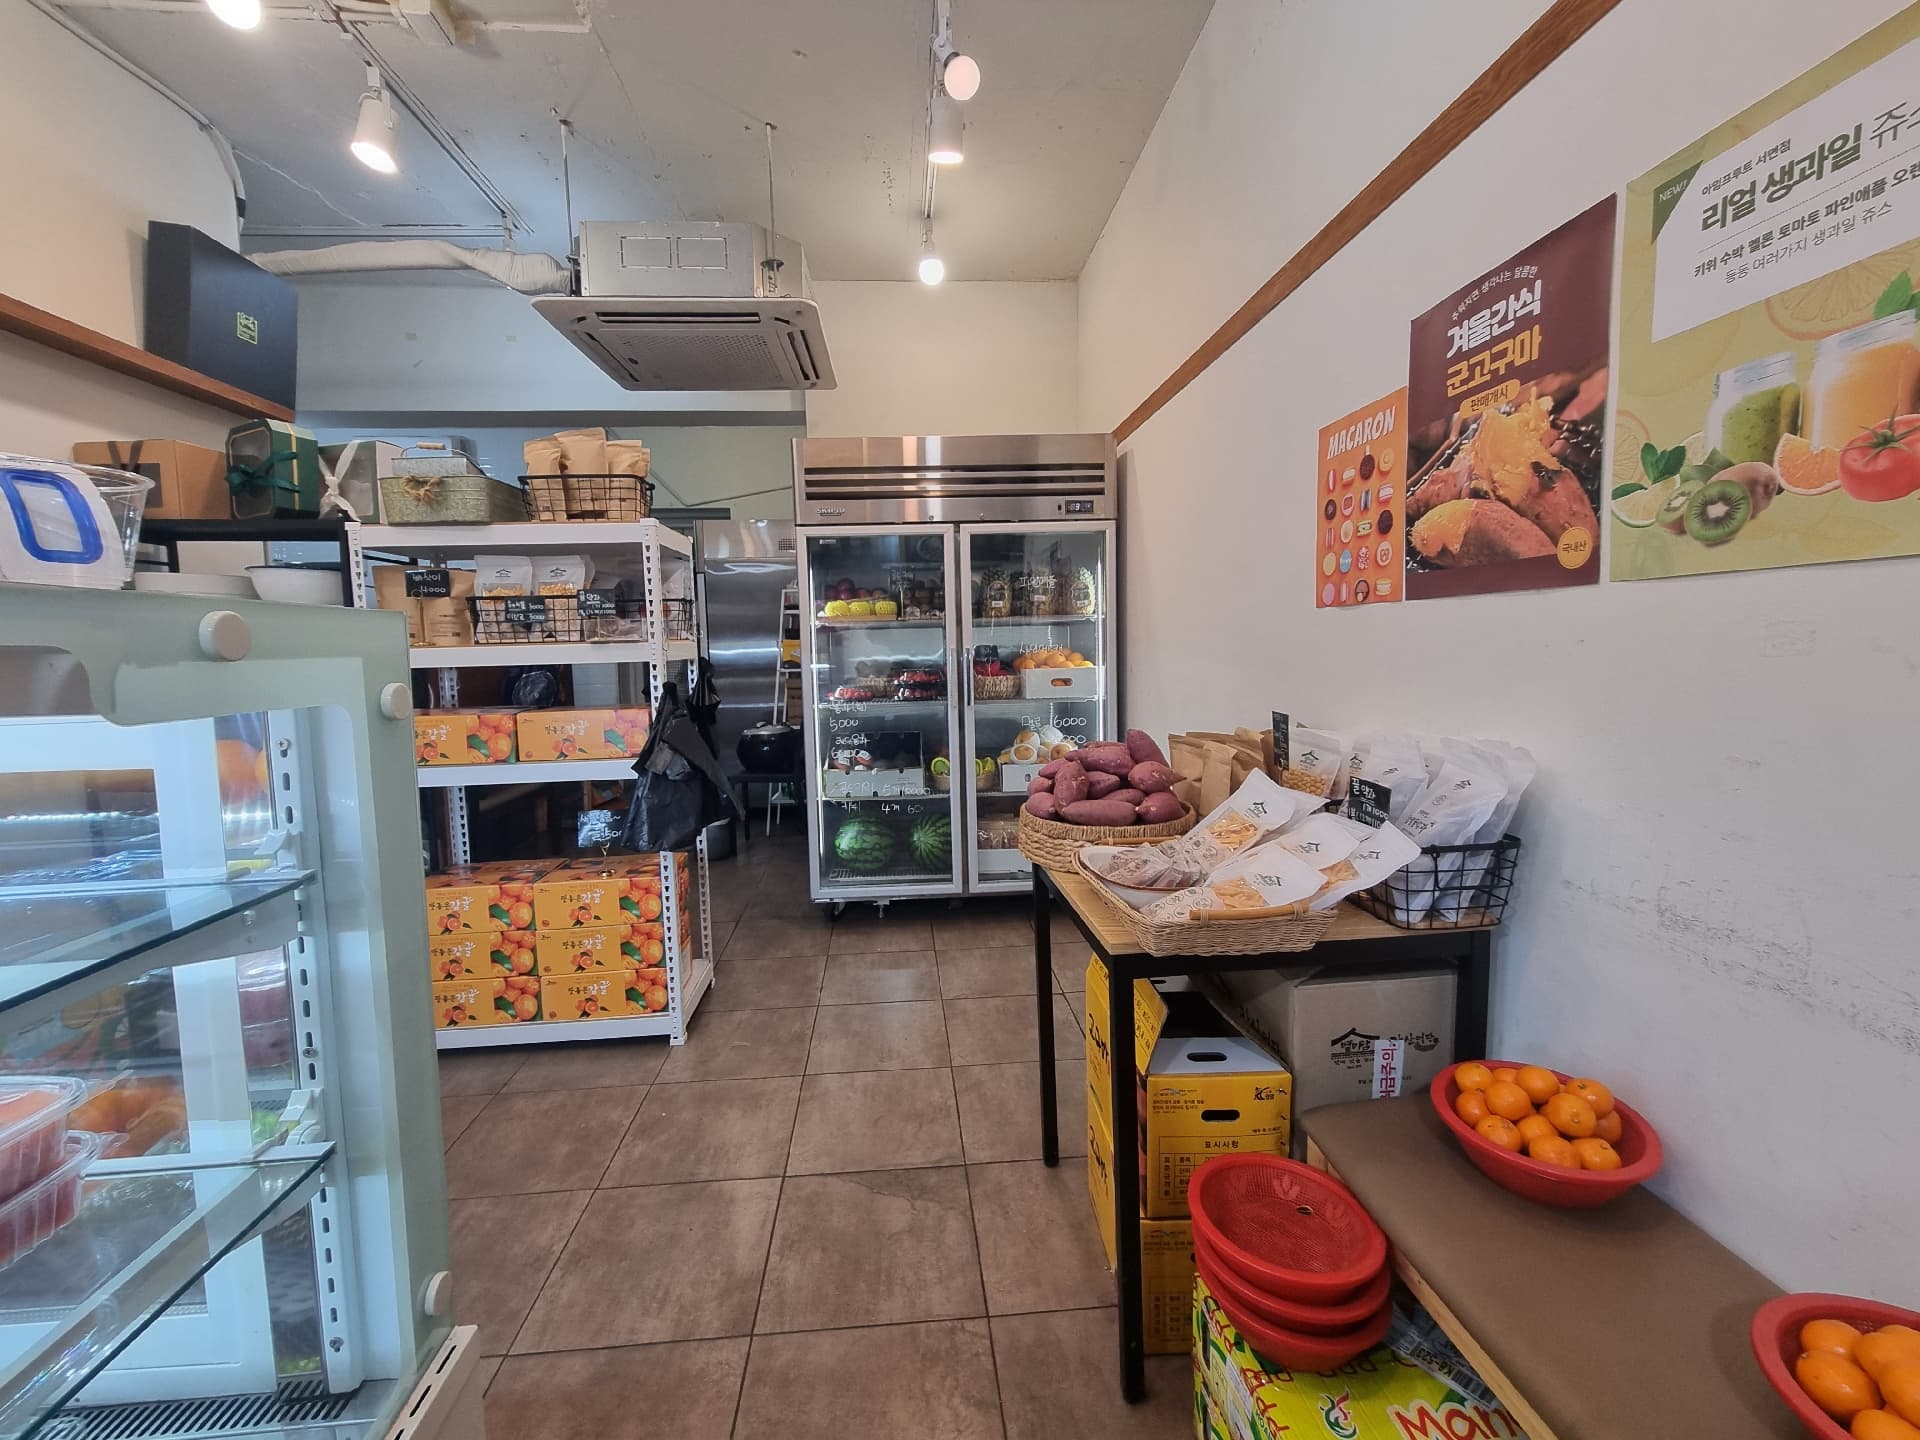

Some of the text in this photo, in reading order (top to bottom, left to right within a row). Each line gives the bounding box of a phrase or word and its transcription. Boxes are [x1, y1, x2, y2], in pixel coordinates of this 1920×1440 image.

[1701, 179, 1757, 232] 리얼
[1761, 123, 1863, 204] 생과일
[1702, 139, 1792, 196] 아임프루트 서면점
[1659, 179, 1689, 202] NEW!
[1694, 258, 1718, 278] 키위
[1720, 247, 1745, 267] 수박
[1748, 231, 1774, 254] 멜론
[1778, 210, 1821, 239] 토마토
[1824, 176, 1888, 218] 파인애플
[1752, 239, 1808, 271] 여러가지
[1813, 216, 1856, 246] 생과일
[1861, 201, 1893, 225] 쥬스
[1481, 270, 1512, 293] 생각나는
[1514, 265, 1538, 279] 달콤한
[1446, 279, 1542, 358] 겨울간식
[1446, 325, 1542, 397] 군고구마
[1470, 385, 1509, 412] 판매개시
[1327, 406, 1397, 460] MACARON
[1561, 540, 1587, 554] 국내산
[1054, 715, 1087, 728] 6000
[1205, 1141, 1239, 1149] 표시사항
[1395, 1405, 1524, 1440] Man
